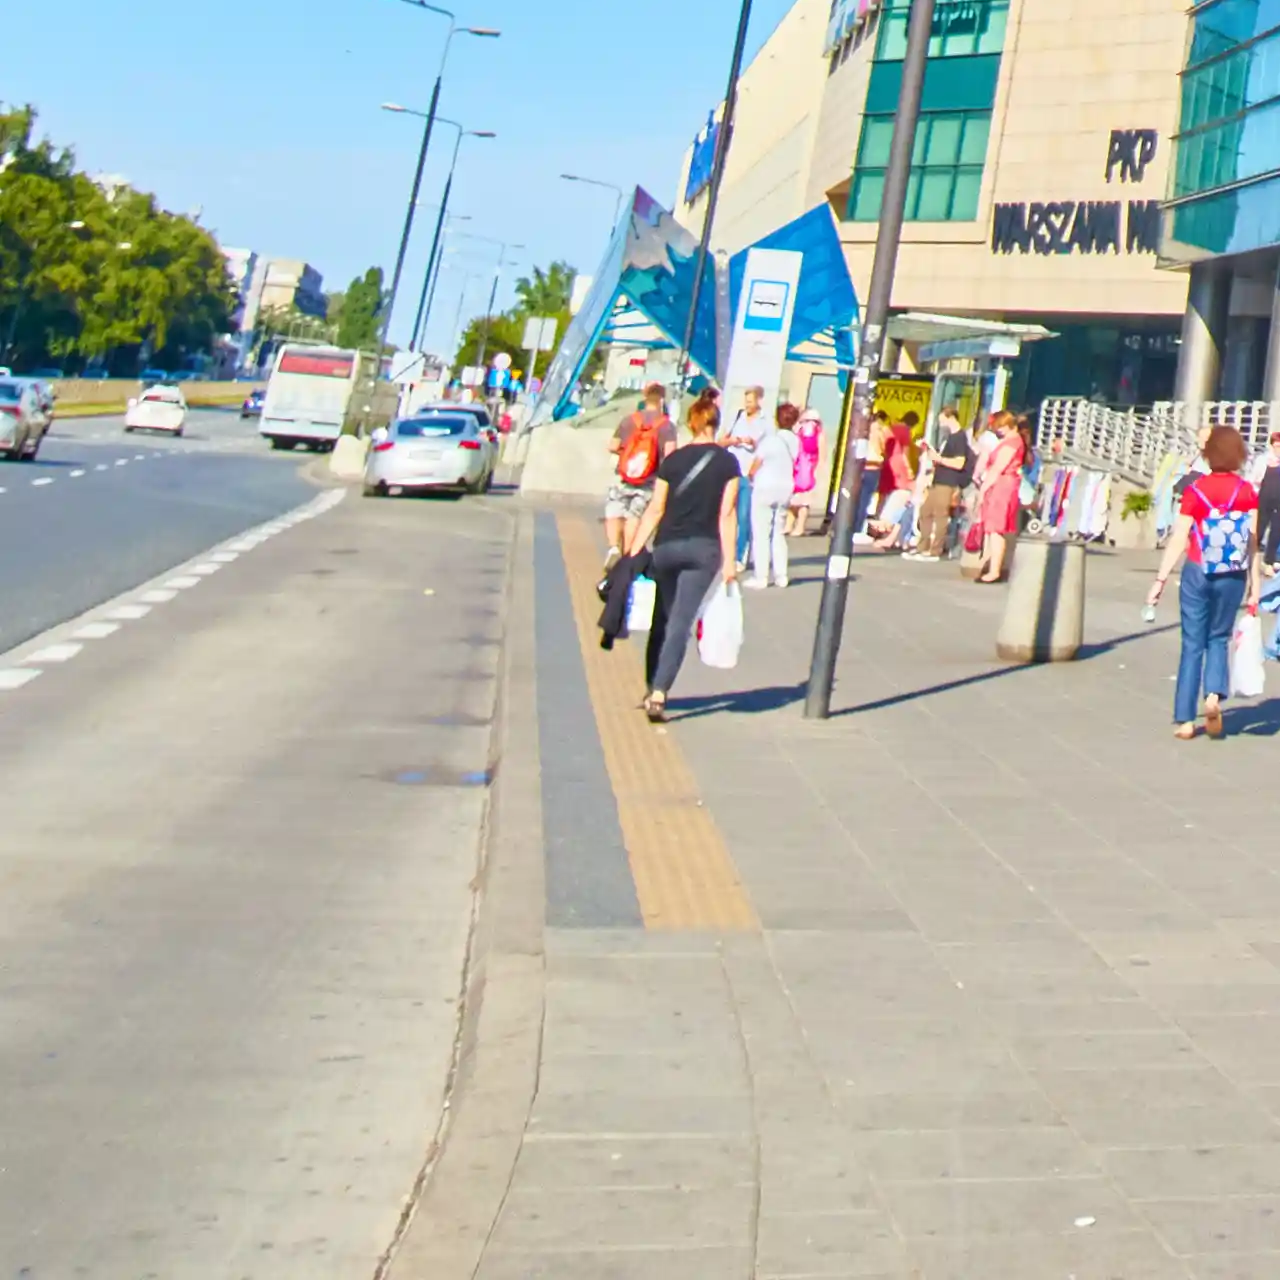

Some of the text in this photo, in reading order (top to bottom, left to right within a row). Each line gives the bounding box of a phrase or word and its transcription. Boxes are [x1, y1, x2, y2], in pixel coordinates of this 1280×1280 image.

[1105, 128, 1158, 184] PKP
[991, 200, 1122, 256] WARSZAWA
[875, 386, 925, 404] WAGA
